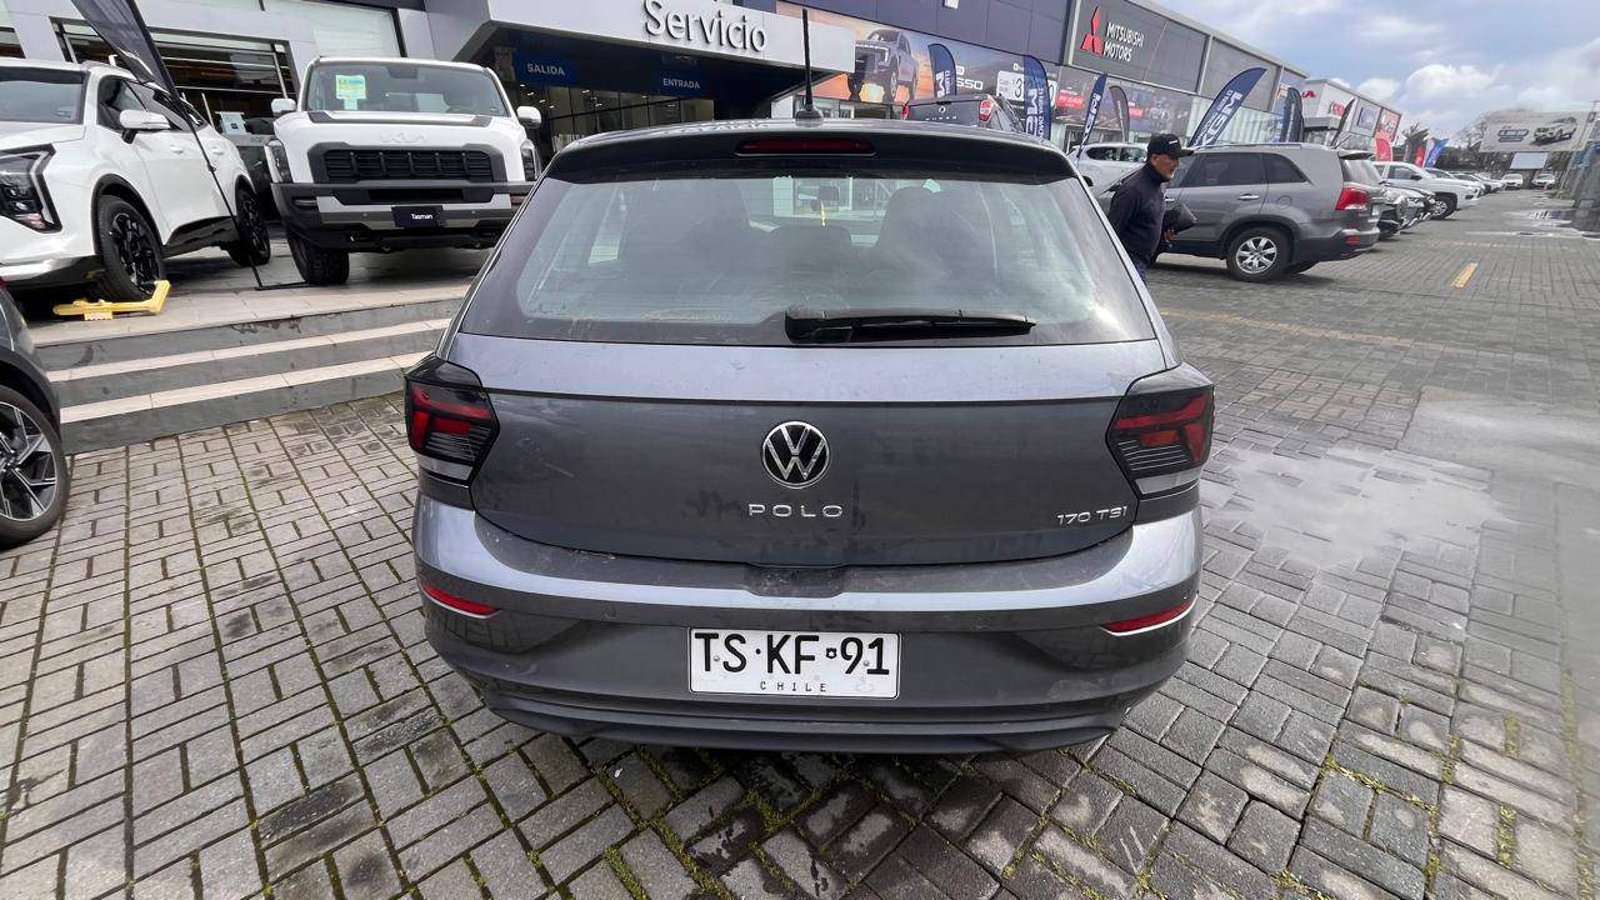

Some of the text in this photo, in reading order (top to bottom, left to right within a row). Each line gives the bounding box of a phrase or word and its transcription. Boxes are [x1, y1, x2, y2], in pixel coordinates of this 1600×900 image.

[644, 0, 765, 52] Servicio
[1106, 22, 1144, 47] MITSUBISHI
[1103, 41, 1132, 61] MOTORS
[527, 63, 565, 77] SALIDA
[662, 77, 701, 90] ENTRADA
[956, 78, 984, 90] SSO
[410, 212, 434, 220] Tasman
[748, 503, 843, 517] POLO
[1057, 505, 1128, 525] 170 TSI
[759, 680, 827, 693] CHILE
